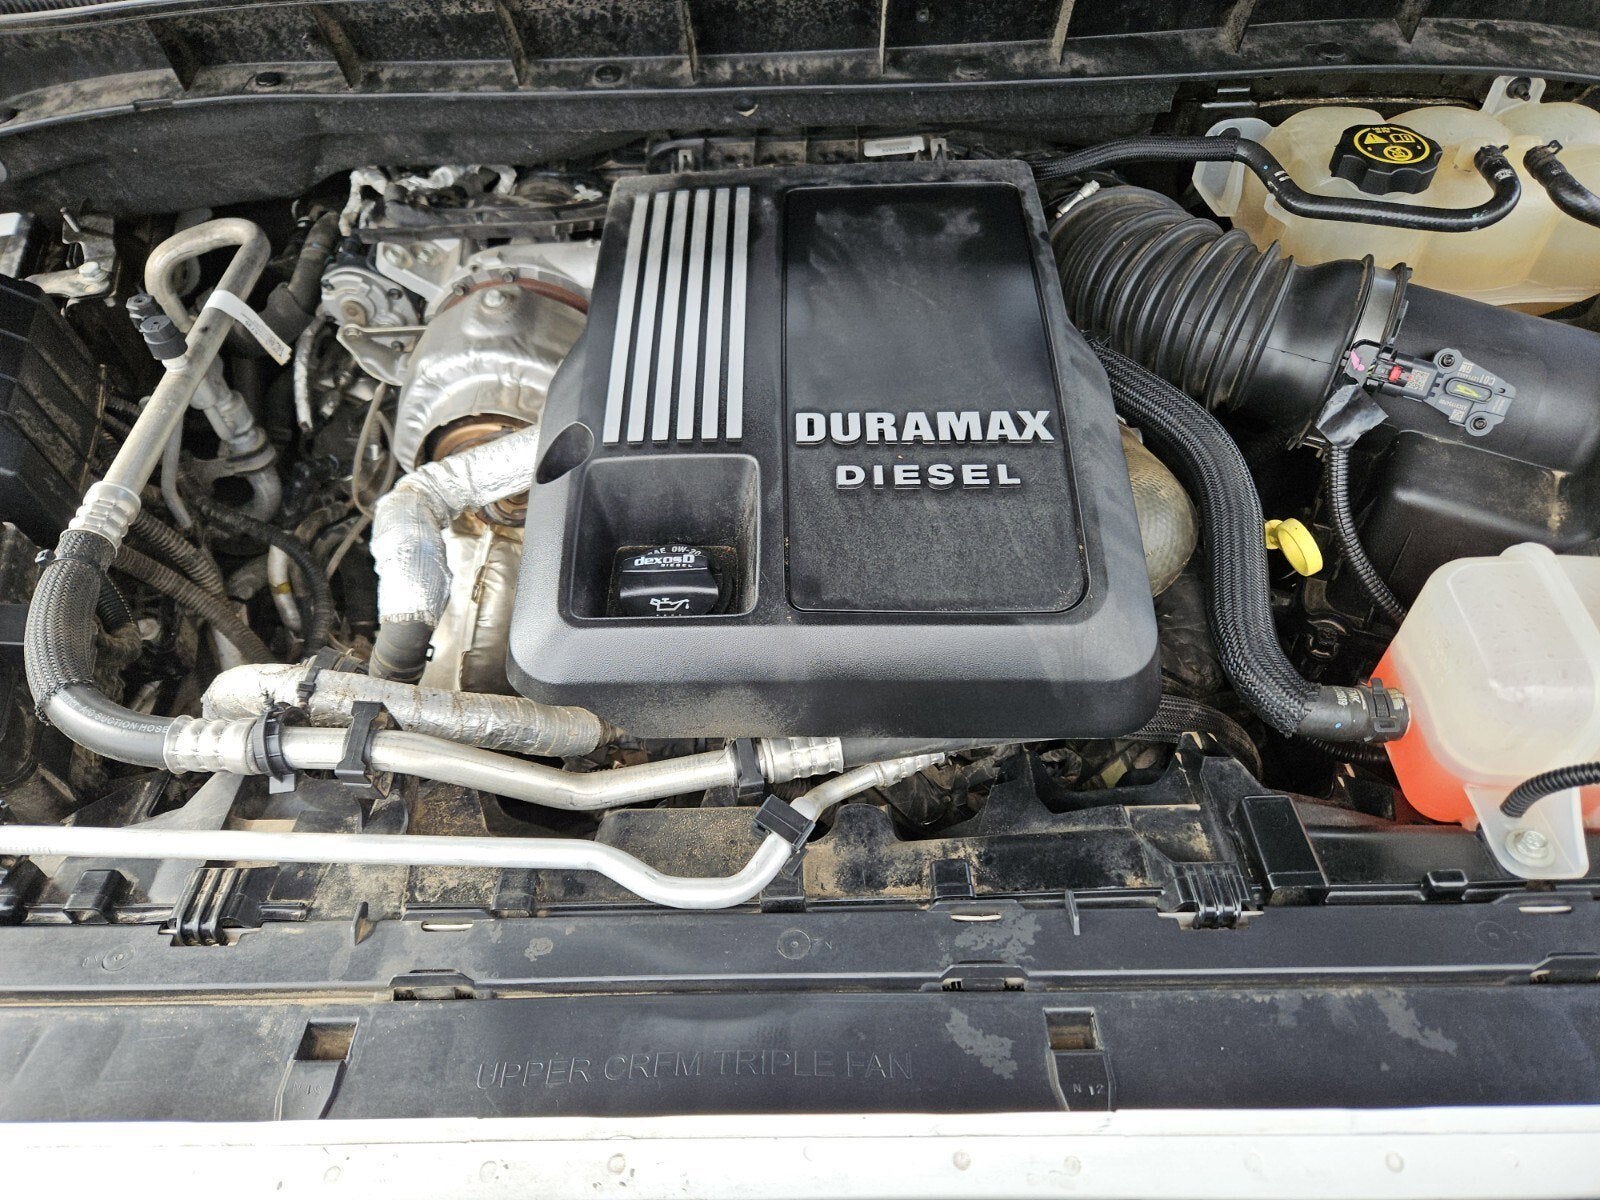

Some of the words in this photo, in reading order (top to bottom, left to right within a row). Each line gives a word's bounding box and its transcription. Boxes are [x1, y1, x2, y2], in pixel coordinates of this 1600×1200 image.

[795, 410, 1055, 445] DURAMAX
[836, 463, 1022, 490] DIESEL
[95, 712, 139, 730] SUCTION
[138, 724, 169, 734] HOSE
[474, 1057, 592, 1090] UPPER
[603, 1052, 702, 1082] CRFM
[714, 1049, 836, 1078] TRIPLE
[845, 1051, 914, 1080] FAN
